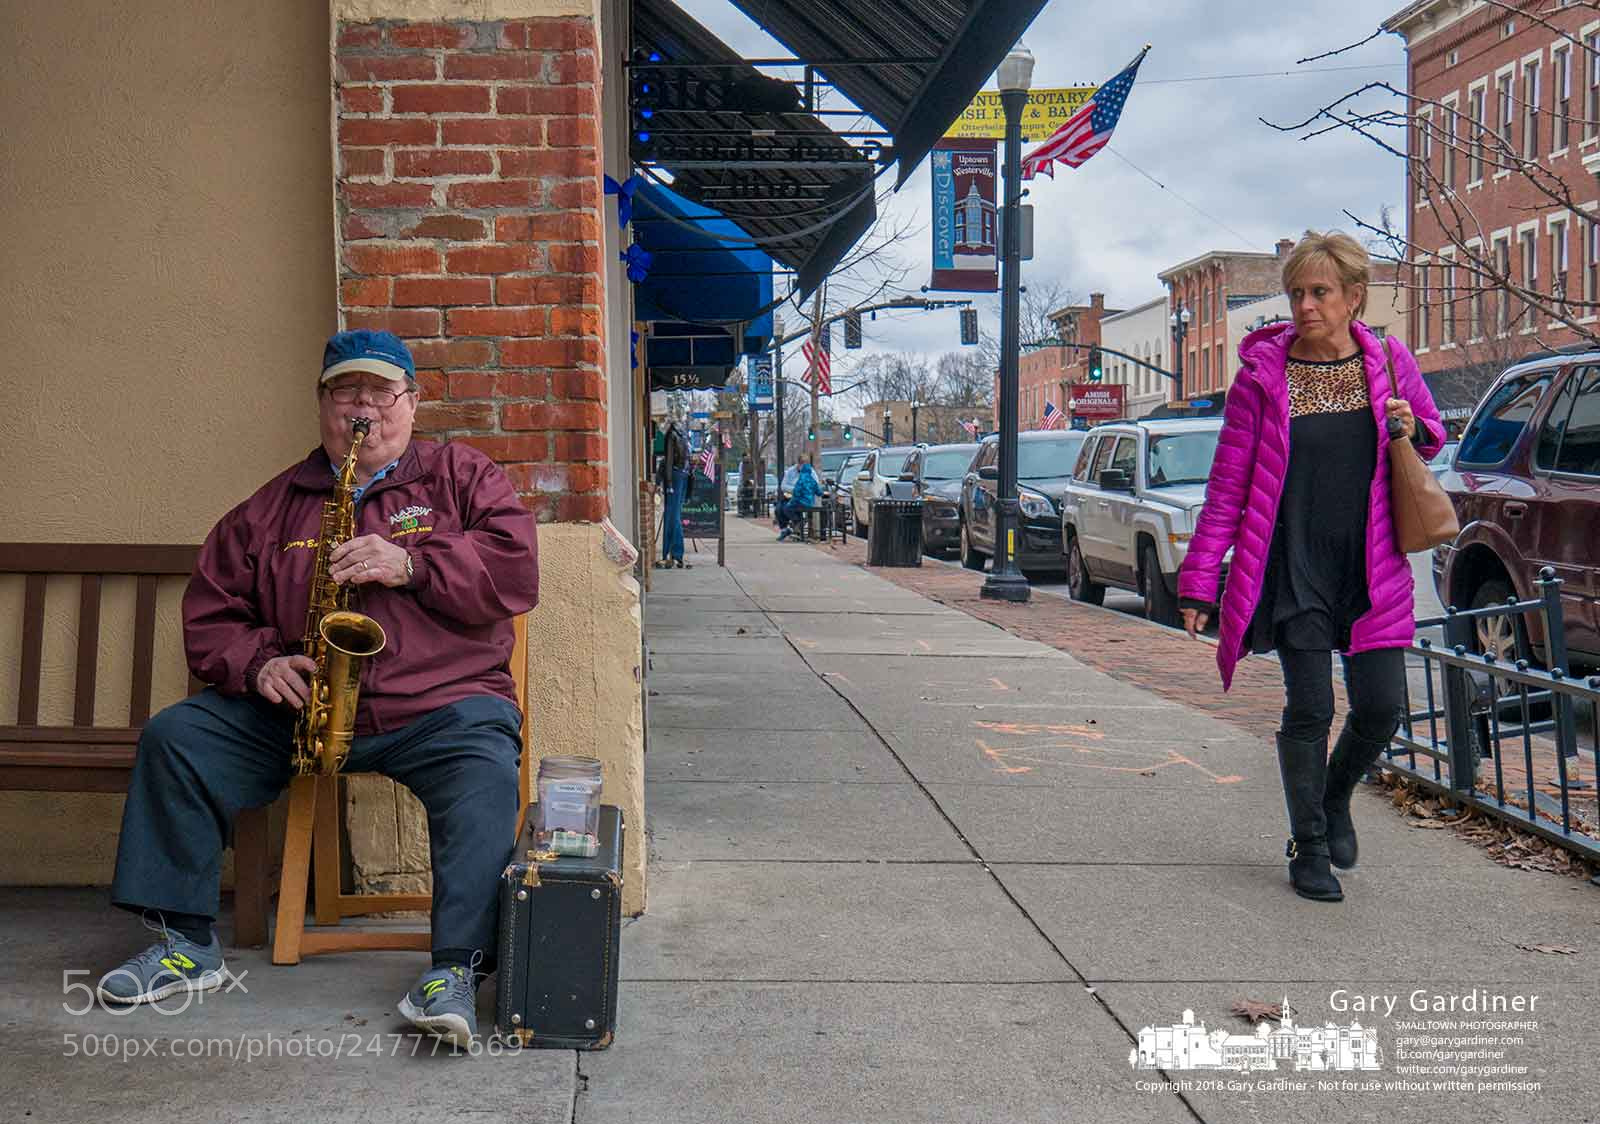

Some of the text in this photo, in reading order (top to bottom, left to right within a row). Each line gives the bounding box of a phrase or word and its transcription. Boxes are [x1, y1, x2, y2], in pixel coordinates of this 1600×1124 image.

[1027, 92, 1088, 104] ROTARY
[1030, 108, 1041, 118] &
[958, 154, 989, 165] Uptown
[953, 166, 994, 179] Westerville
[936, 173, 951, 260] Discover
